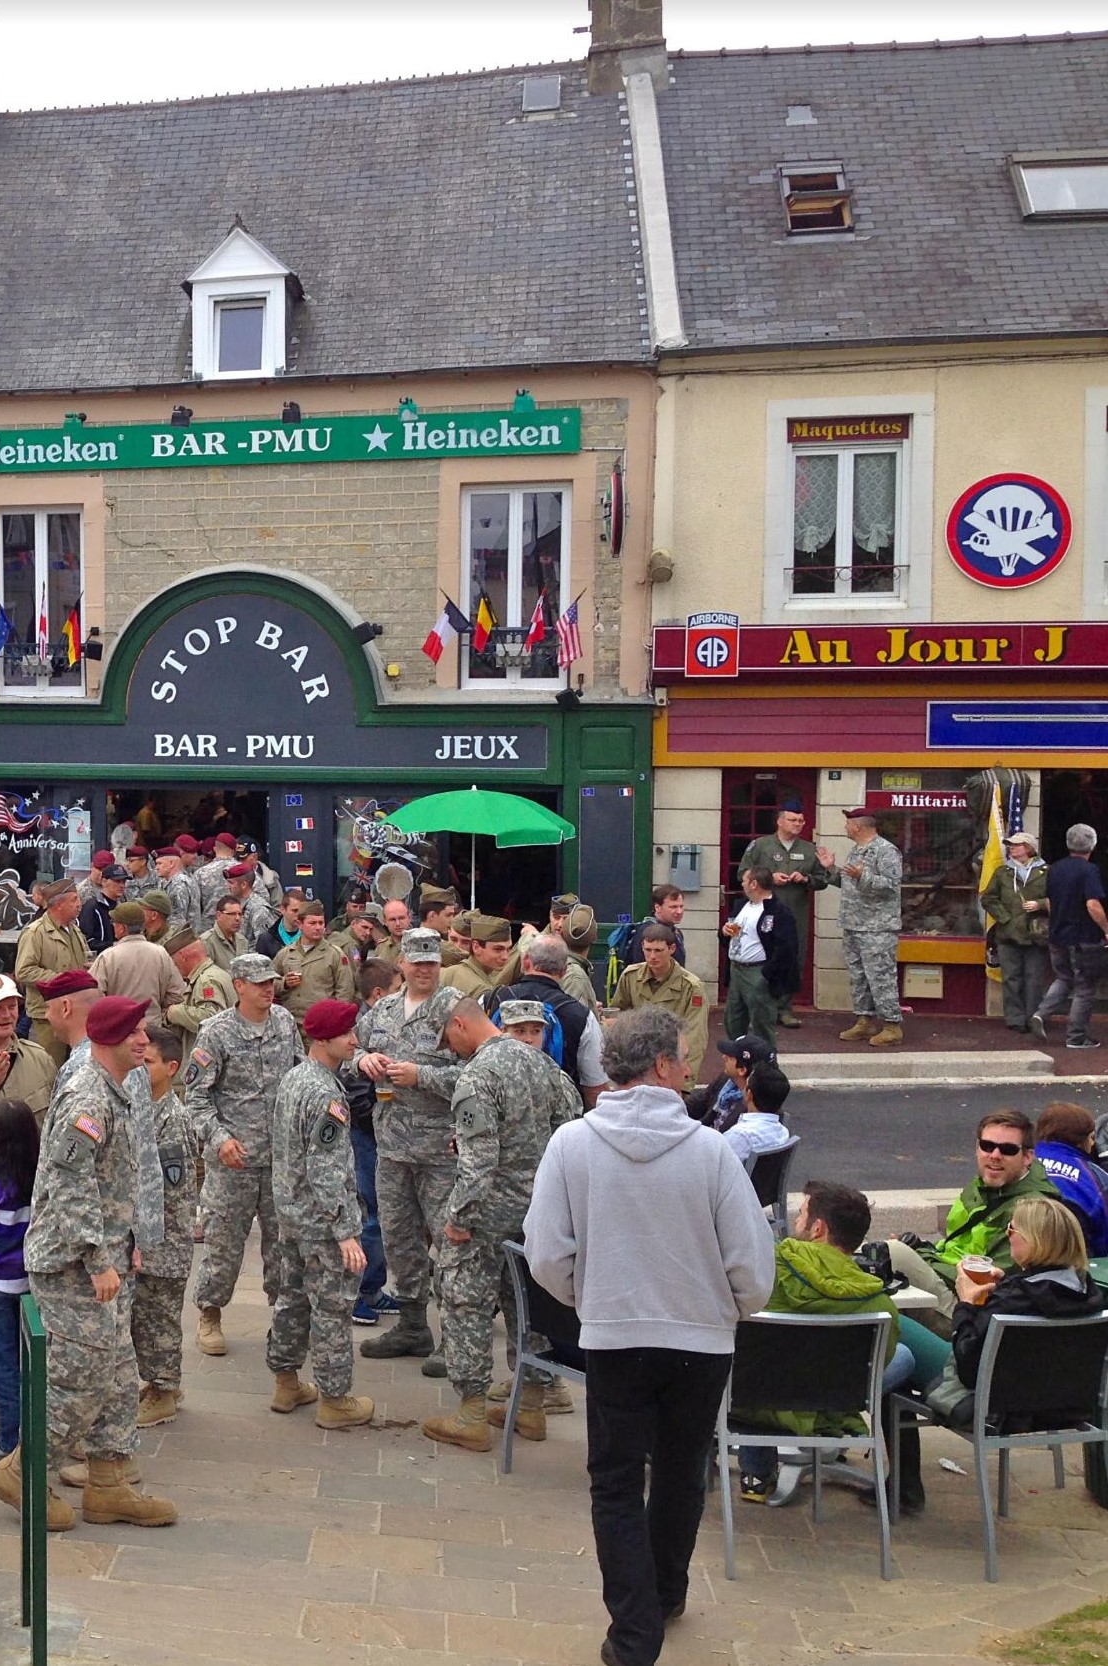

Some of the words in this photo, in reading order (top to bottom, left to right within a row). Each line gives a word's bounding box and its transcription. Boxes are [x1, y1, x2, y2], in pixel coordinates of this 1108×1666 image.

[151, 432, 229, 457] BAR
[402, 418, 562, 451] Heineken
[792, 420, 903, 440] Maquettes
[689, 613, 738, 627] AIRBORNE
[779, 630, 852, 665] Au
[876, 628, 1009, 664] Jour
[1034, 627, 1069, 662] J
[151, 616, 238, 704] STOP
[255, 620, 330, 704] BAR
[154, 734, 218, 757] BAR
[246, 735, 315, 759] PMU
[435, 735, 520, 760] JEUX
[639, 773, 646, 781] 3
[832, 772, 839, 780] 5
[890, 795, 968, 808] Militaria
